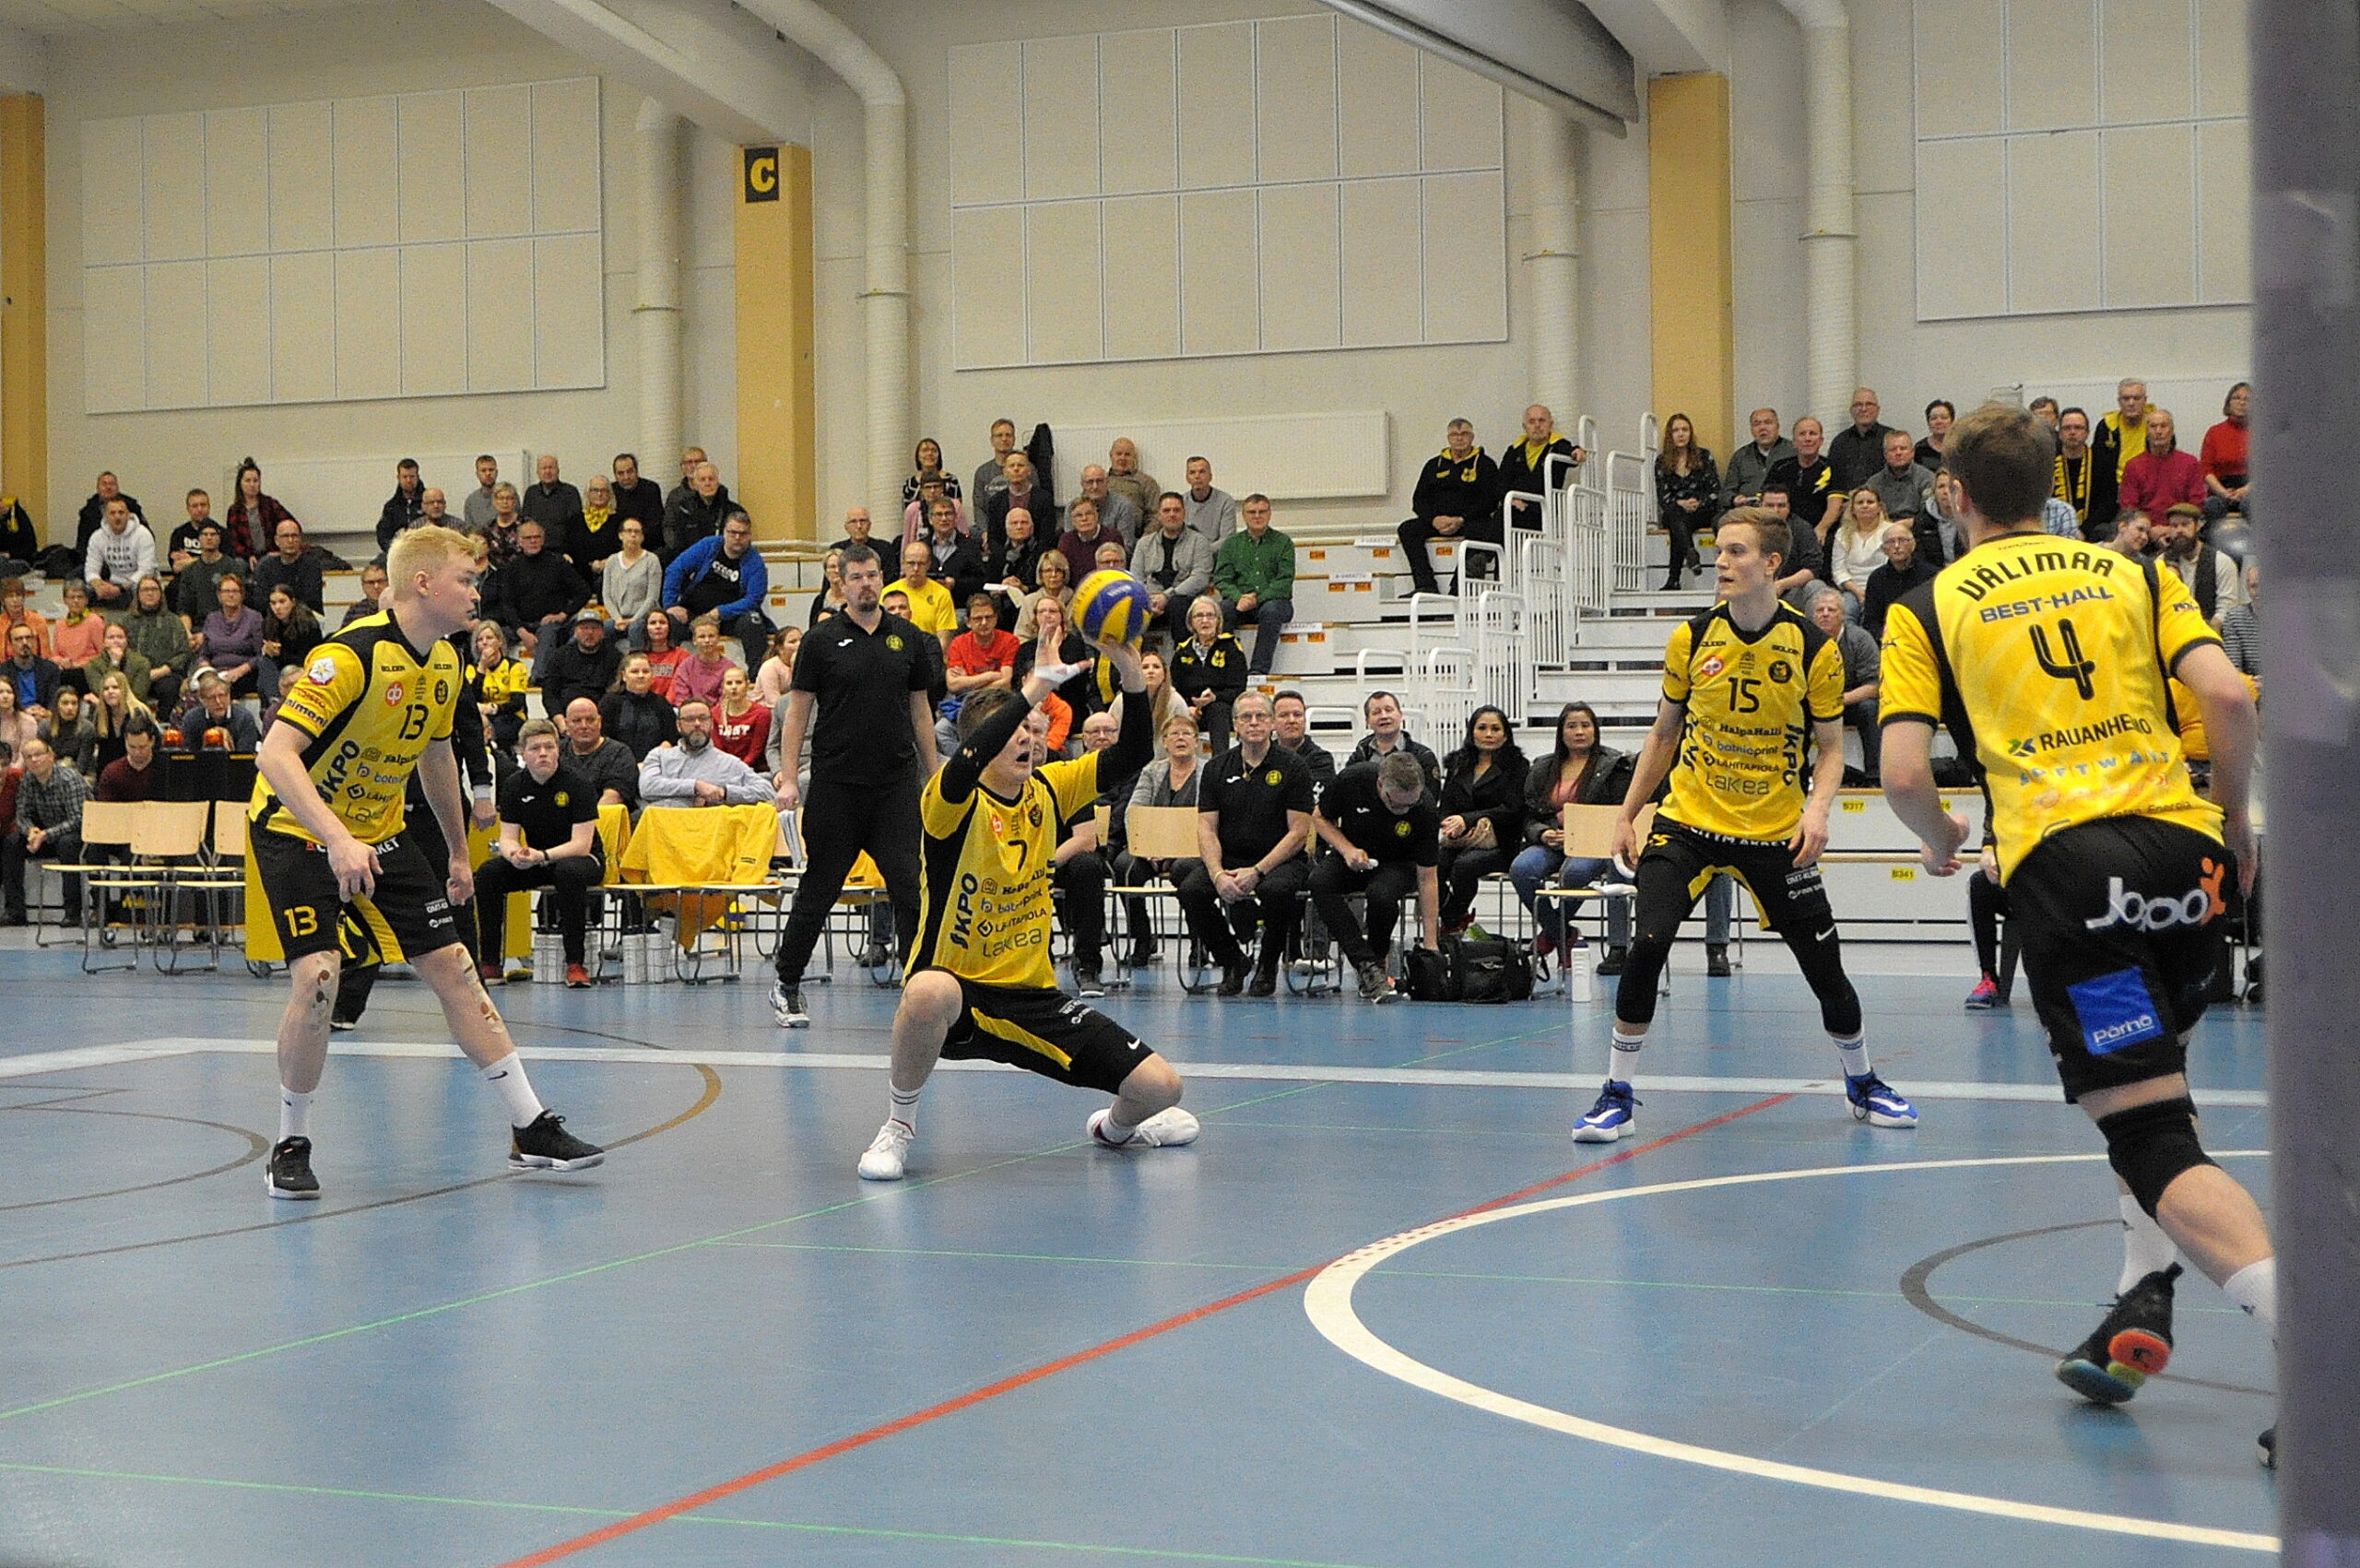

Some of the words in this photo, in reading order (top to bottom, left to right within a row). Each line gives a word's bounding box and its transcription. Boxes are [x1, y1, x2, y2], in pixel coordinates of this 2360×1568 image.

[750, 158, 775, 193] C
[1956, 551, 2114, 602] VÄLIMAA
[1979, 585, 2115, 624] BEST-HALL
[2028, 618, 2096, 701] 4
[1728, 677, 1762, 713] 15
[398, 704, 430, 740] 13
[1719, 724, 1782, 737] HalpaHalli
[2039, 713, 2153, 751] RAUANHEO
[1705, 772, 1769, 796] Lakea
[1008, 840, 1028, 872] 7
[284, 905, 318, 938] 13
